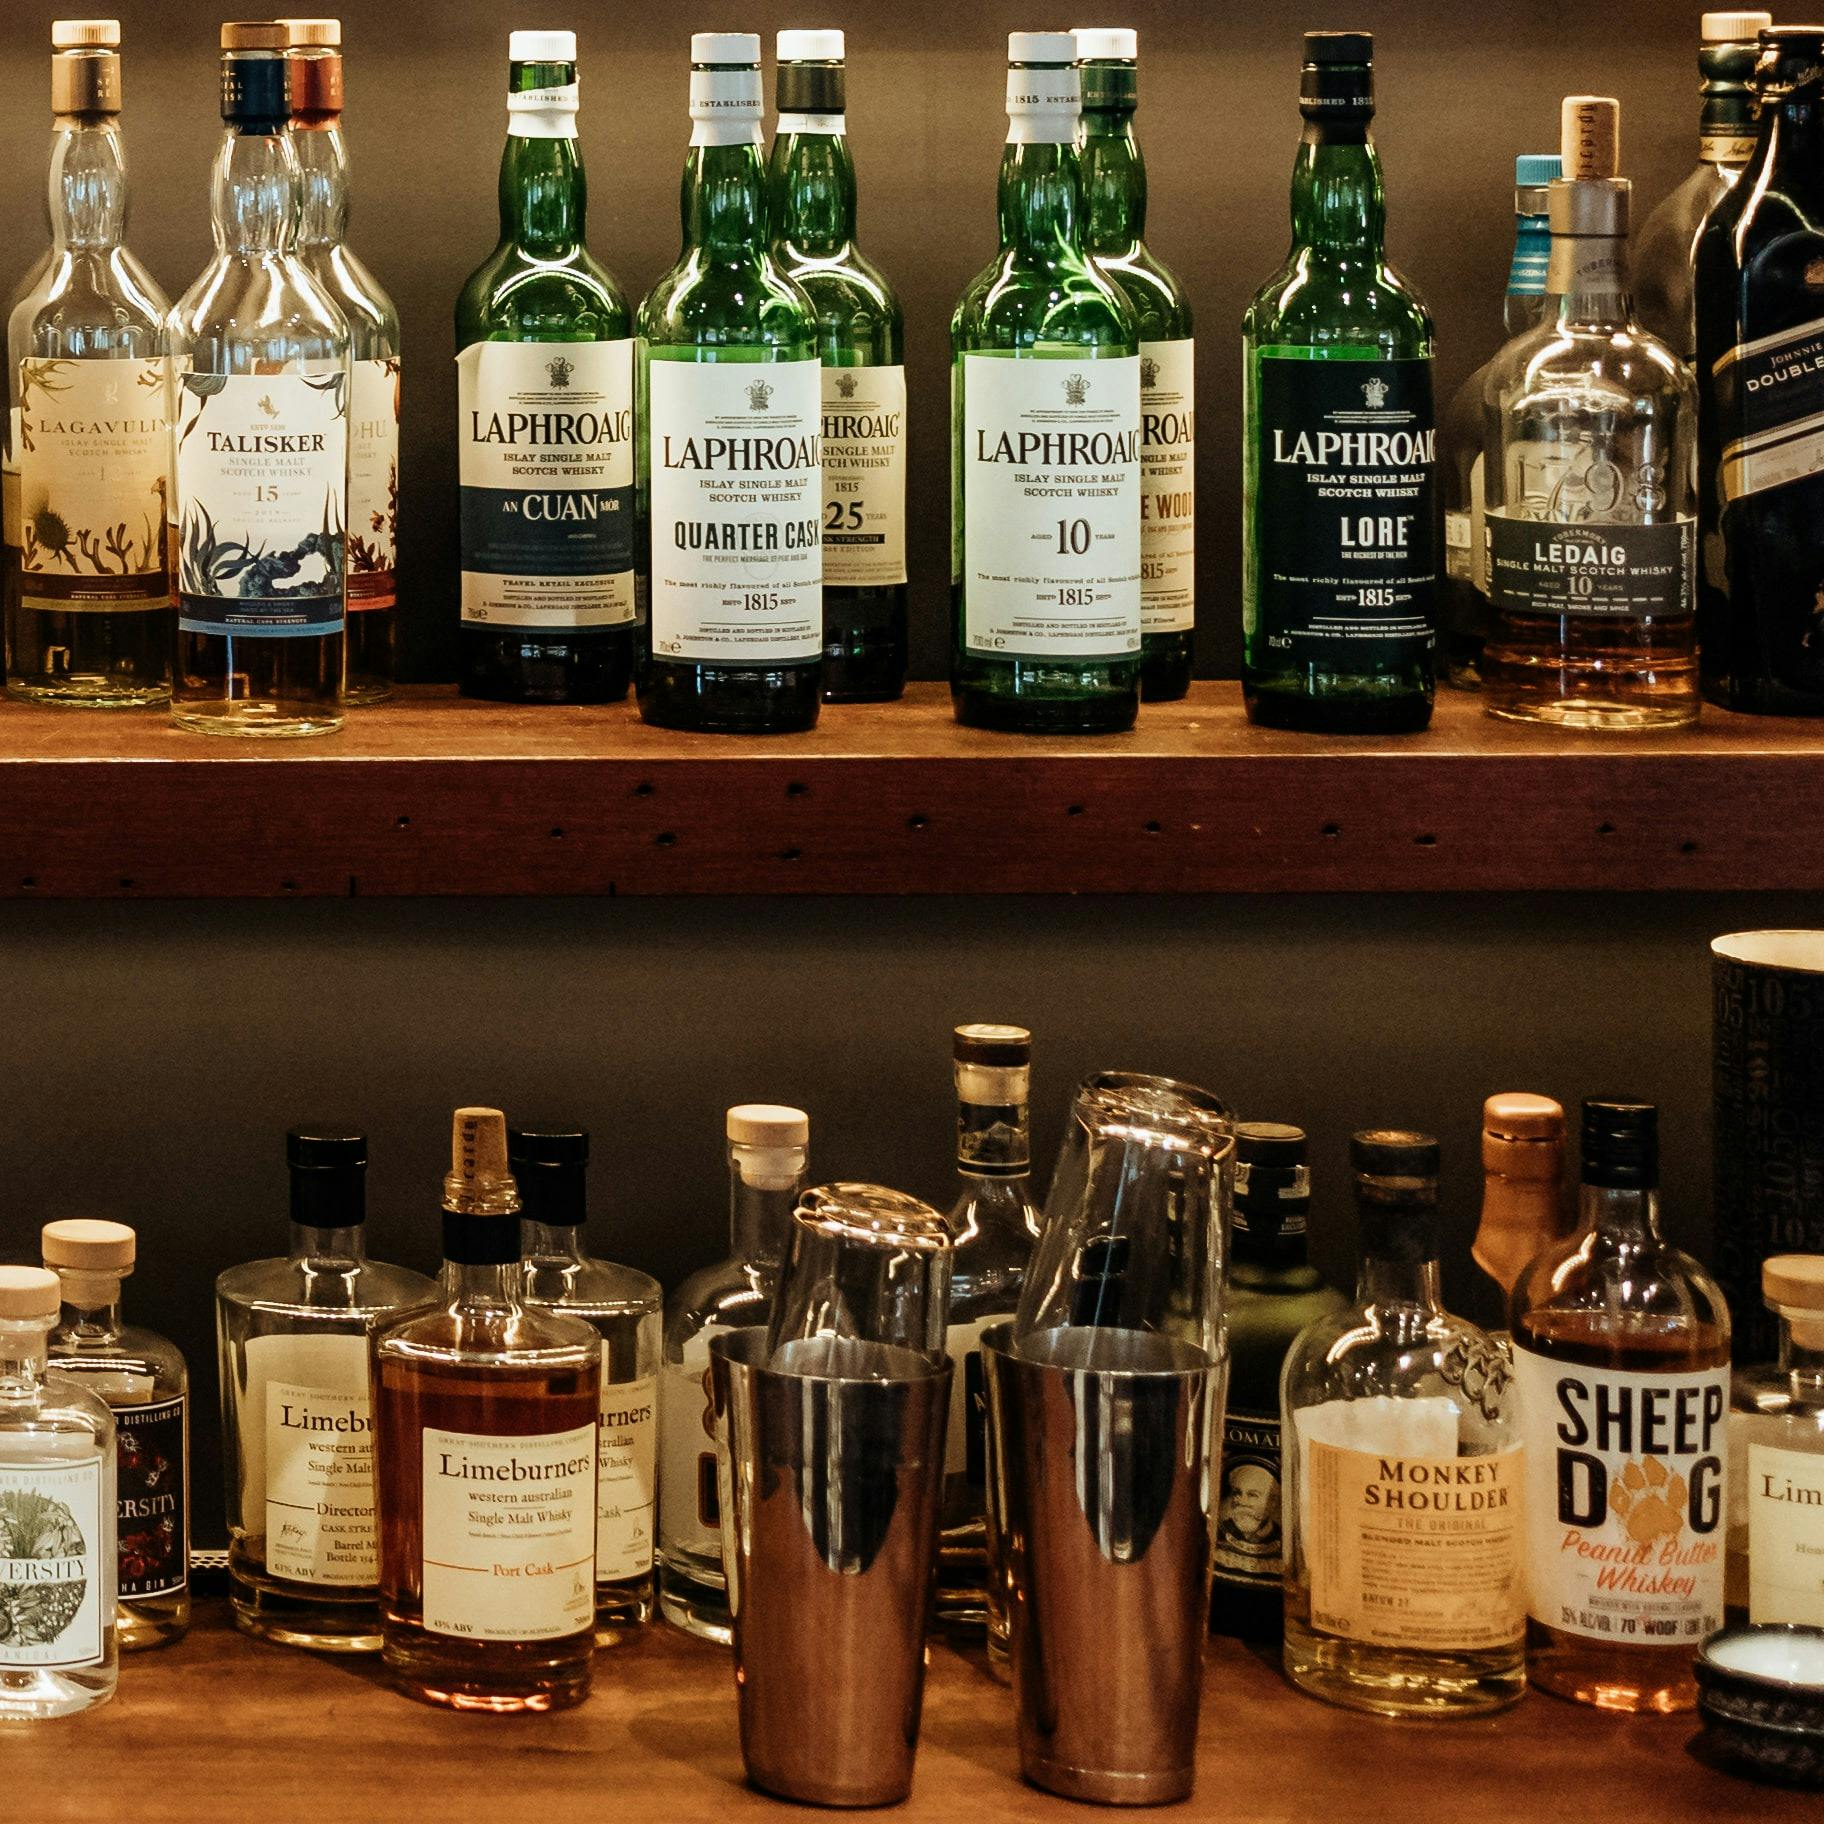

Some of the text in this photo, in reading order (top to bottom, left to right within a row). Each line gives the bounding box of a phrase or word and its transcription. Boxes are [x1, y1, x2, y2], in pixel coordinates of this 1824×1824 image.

[39, 419, 169, 434] LAGAVULIN
[472, 410, 632, 444] LAPHROAIG
[207, 432, 326, 453] TALISKER
[522, 494, 598, 522] CUAN
[675, 520, 819, 551] QUARTER CASK
[1341, 516, 1408, 546] LORE
[1535, 543, 1626, 565] LEDAIG
[1556, 1378, 1723, 1456] SHEEP
[439, 1452, 590, 1484] Limeburners
[1379, 1460, 1498, 1485] MONKEY
[1364, 1485, 1507, 1510] SHOULDER
[1562, 1528, 1652, 1566] Peanut
[493, 1561, 554, 1578] Port Cask
[1596, 1565, 1695, 1596] Whiskey
